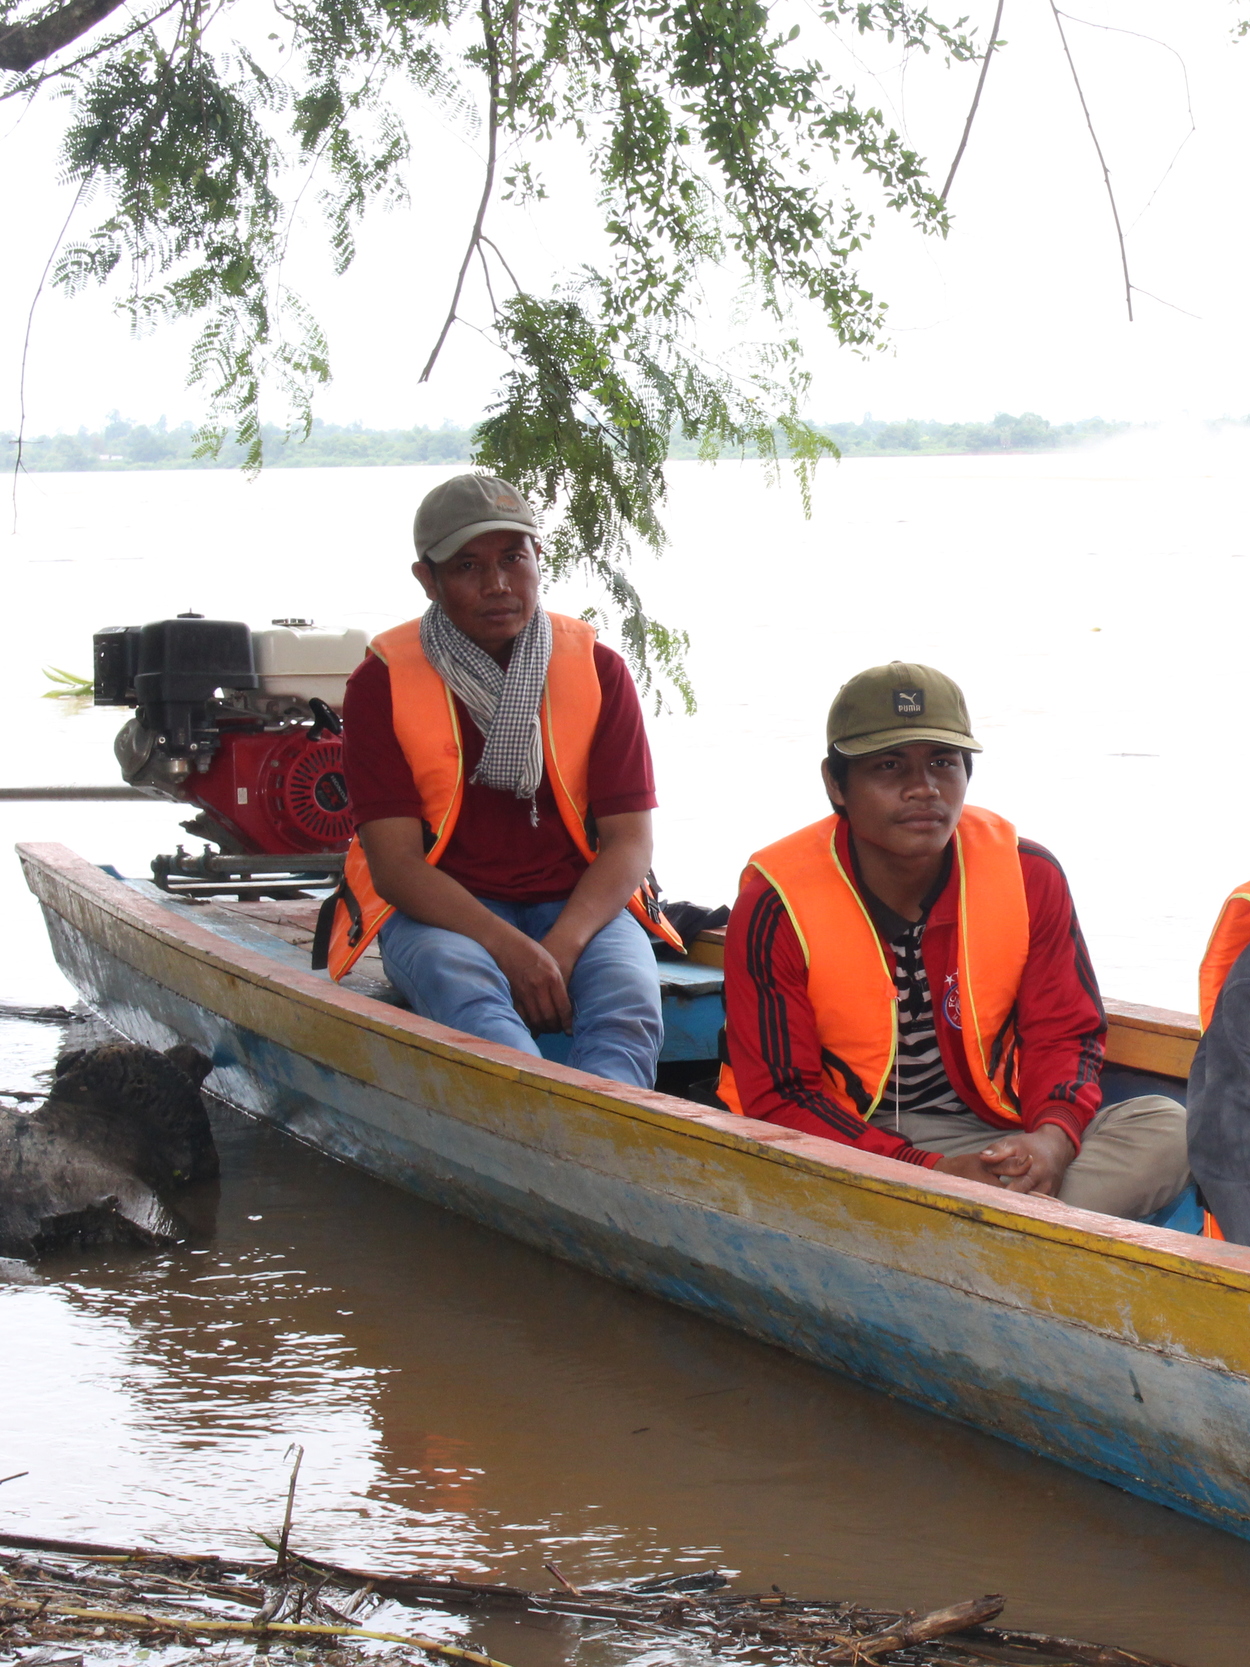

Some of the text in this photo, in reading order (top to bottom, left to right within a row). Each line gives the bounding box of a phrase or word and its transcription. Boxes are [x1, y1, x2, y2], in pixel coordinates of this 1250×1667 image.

[898, 704, 921, 712] PUMA
[330, 775, 348, 803] HONDA
[948, 995, 957, 1008] FC
